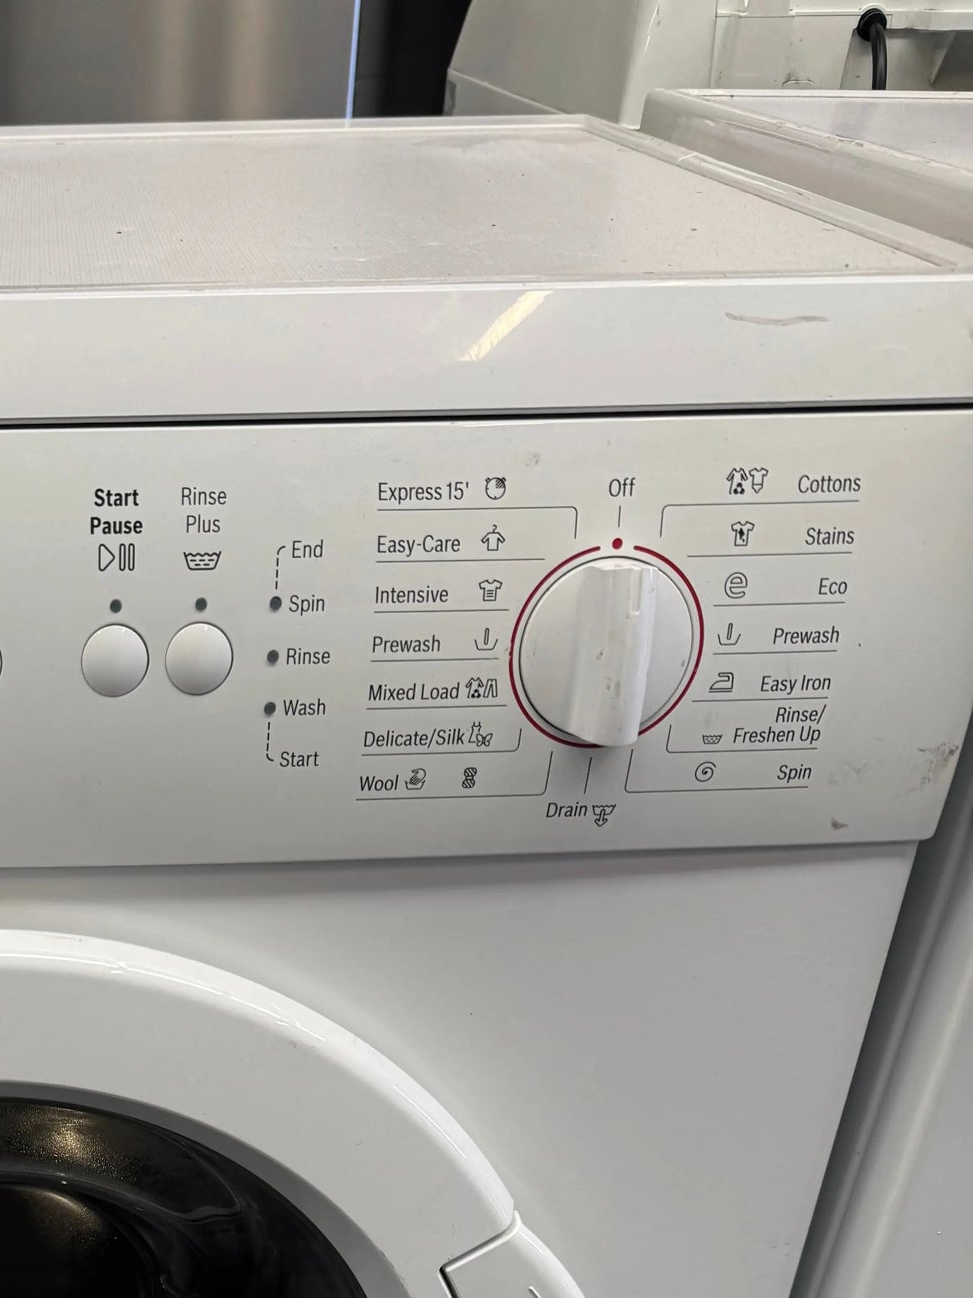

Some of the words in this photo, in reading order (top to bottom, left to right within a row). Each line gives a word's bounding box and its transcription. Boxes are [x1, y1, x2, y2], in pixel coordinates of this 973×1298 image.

[378, 482, 443, 504] Express
[608, 477, 636, 498] Off
[797, 474, 862, 494] Cottons
[93, 487, 140, 508] Start
[181, 486, 227, 506] Rinse
[90, 516, 143, 535] Pause
[186, 513, 221, 534] Plus
[804, 526, 855, 546] Stains
[291, 539, 324, 559] End
[377, 536, 462, 557] Easy-Care
[375, 585, 449, 605] Intensive
[818, 577, 848, 596] Eco
[288, 594, 326, 615] Spin
[372, 634, 441, 654] Prewash
[772, 626, 840, 645] Prewash
[286, 647, 331, 666] Rinse
[368, 683, 417, 702] Mixed
[420, 682, 461, 701] Load
[760, 675, 795, 695] Easy
[798, 674, 832, 692] Iron
[283, 698, 327, 717] Wash
[774, 704, 827, 724] Rinse/
[363, 729, 465, 749] Delicate/Silk
[732, 725, 793, 744] Freshen
[796, 724, 821, 745] Up
[279, 750, 320, 768] Start
[359, 774, 399, 793] Wool
[776, 763, 812, 784] Spin
[545, 801, 588, 819] Drain
